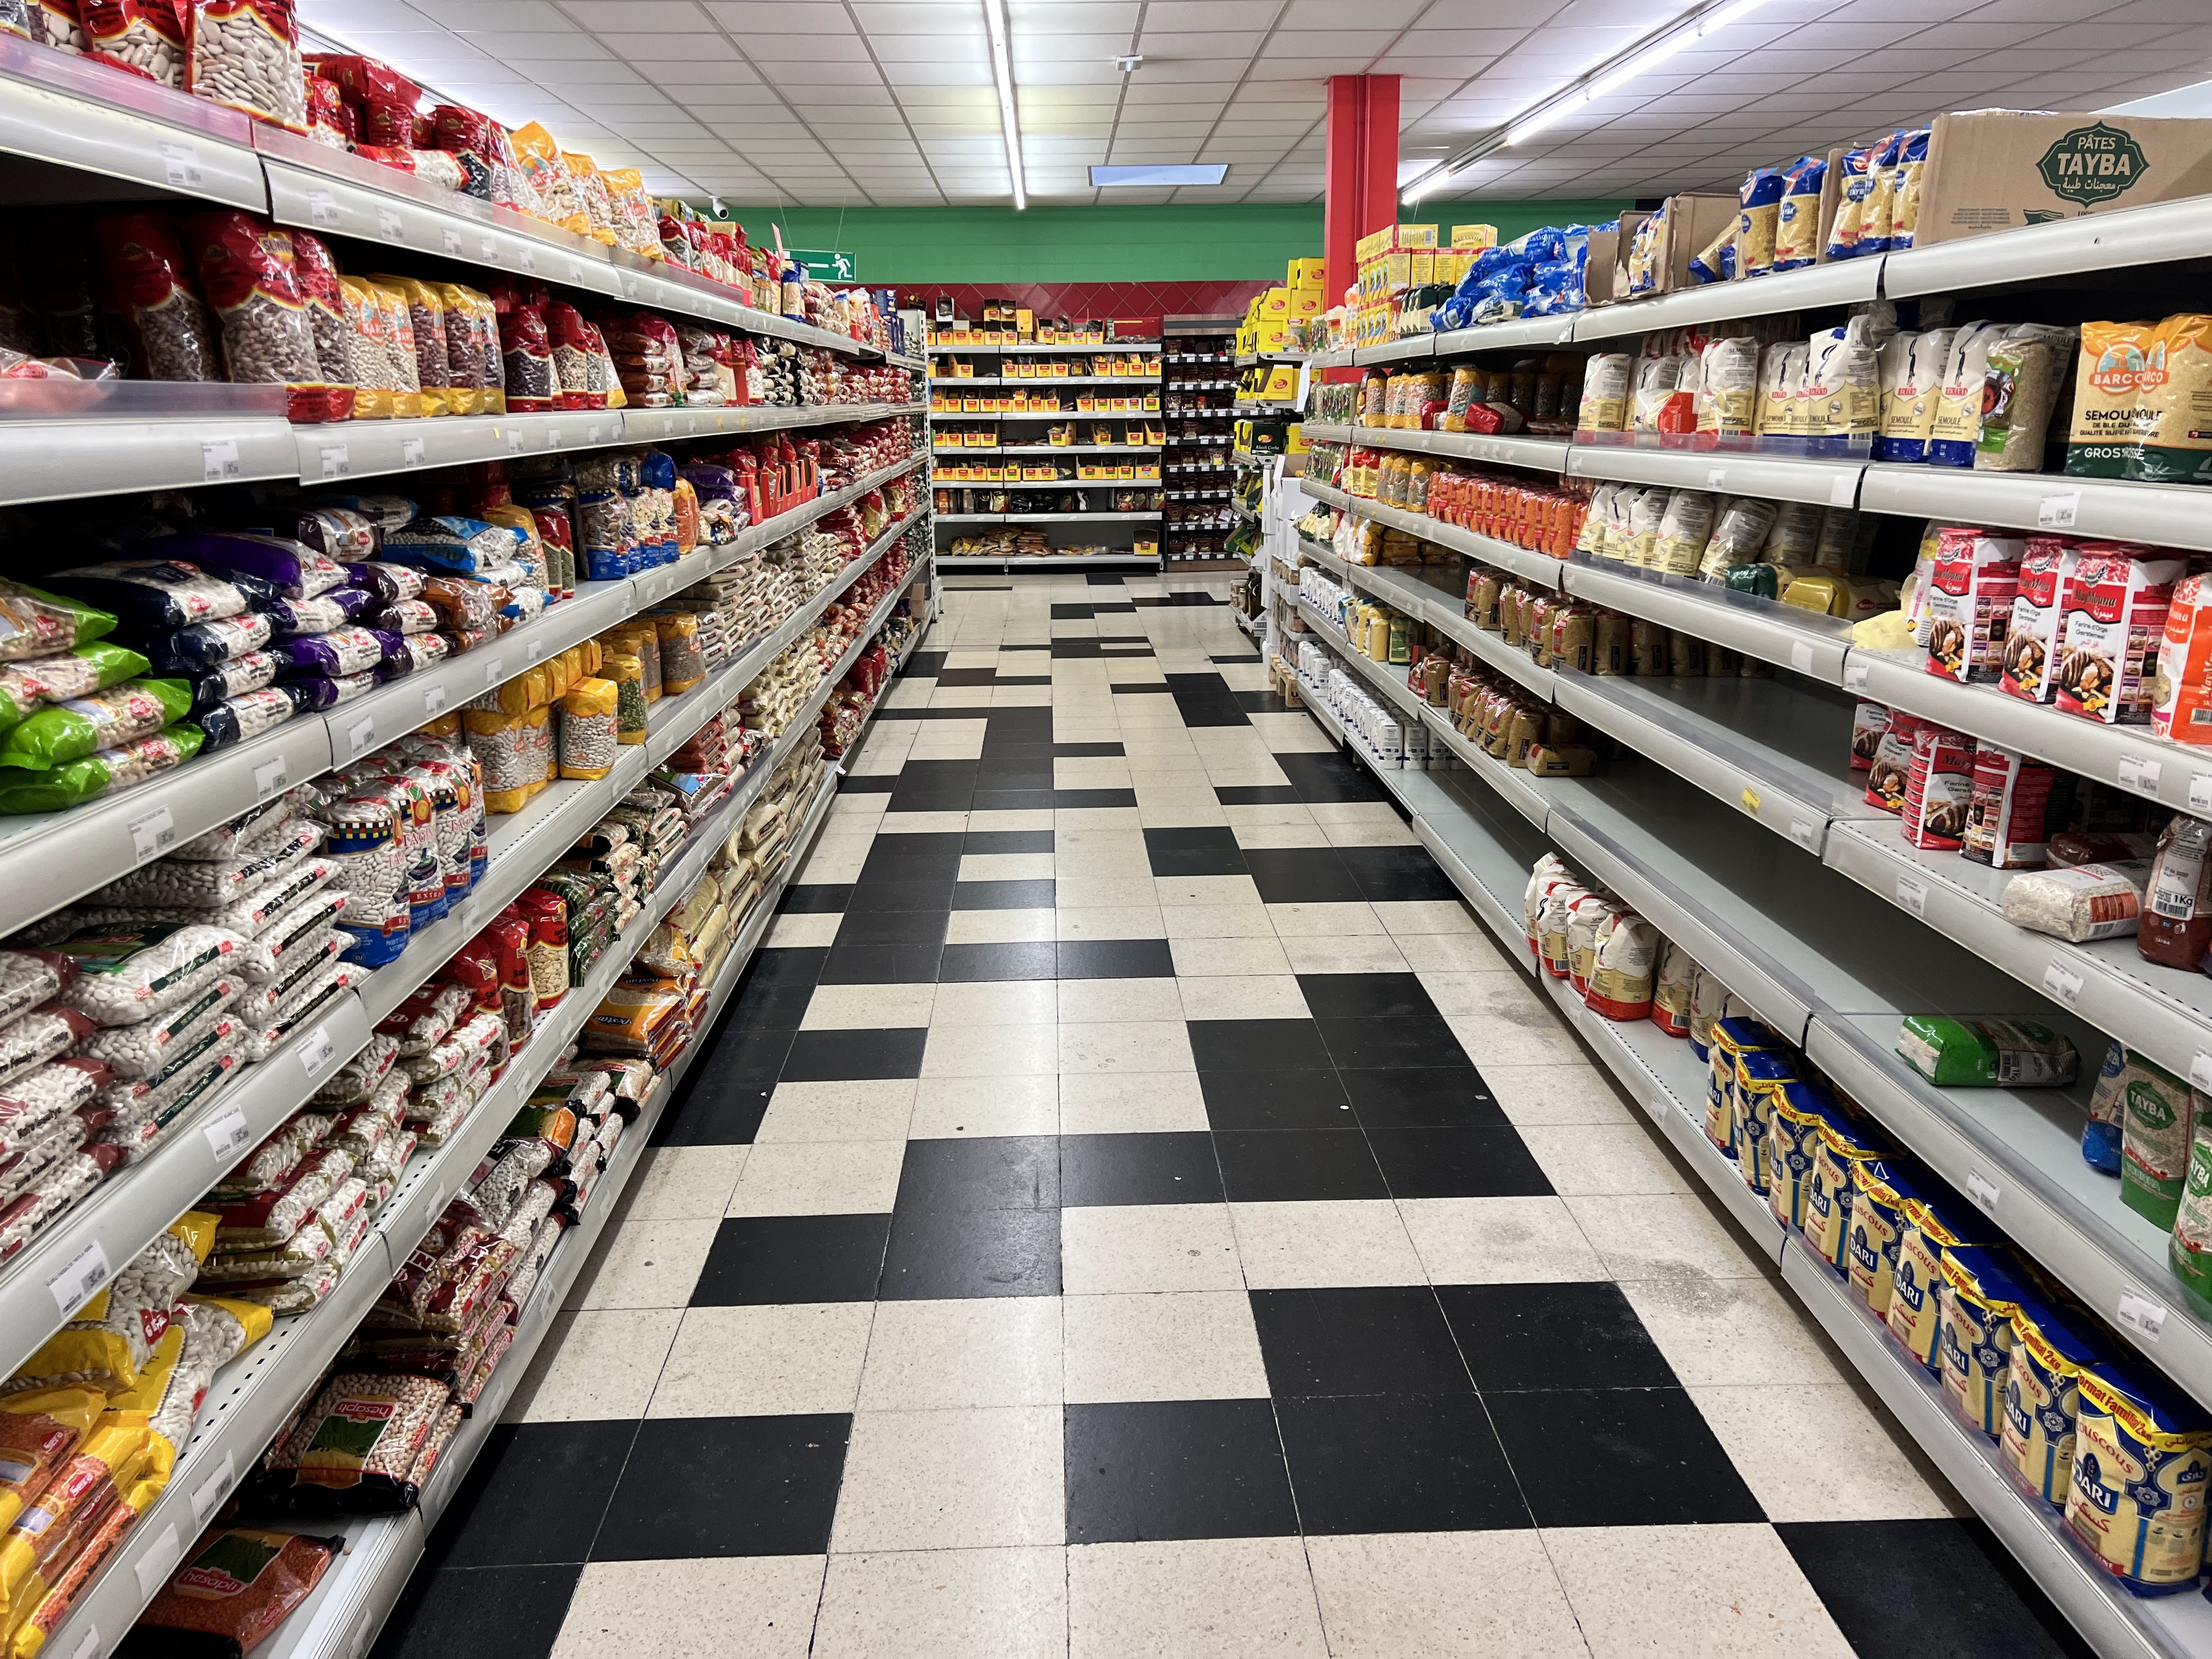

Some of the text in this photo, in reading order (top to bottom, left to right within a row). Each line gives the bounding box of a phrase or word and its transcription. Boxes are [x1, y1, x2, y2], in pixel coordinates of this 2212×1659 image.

[2078, 134, 2115, 149] PÂTES
[2058, 154, 2130, 176] TAYBA
[1891, 416, 1912, 424] SEMOULE
[2085, 410, 2131, 421] SEMOU
[2075, 620, 2091, 629] Farine
[417, 891, 442, 900] EXTRA
[2174, 895, 2193, 907] 1Kg
[2130, 1090, 2166, 1121] TAYBA
[1850, 1237, 1874, 1267] DARI
[1895, 1273, 1920, 1307] DARI
[1942, 1336, 1966, 1370] DARI
[2005, 1398, 2027, 1432] DARI
[43, 1431, 64, 1452] Sera
[69, 1472, 94, 1497] Sera
[2076, 1466, 2112, 1509] DARI
